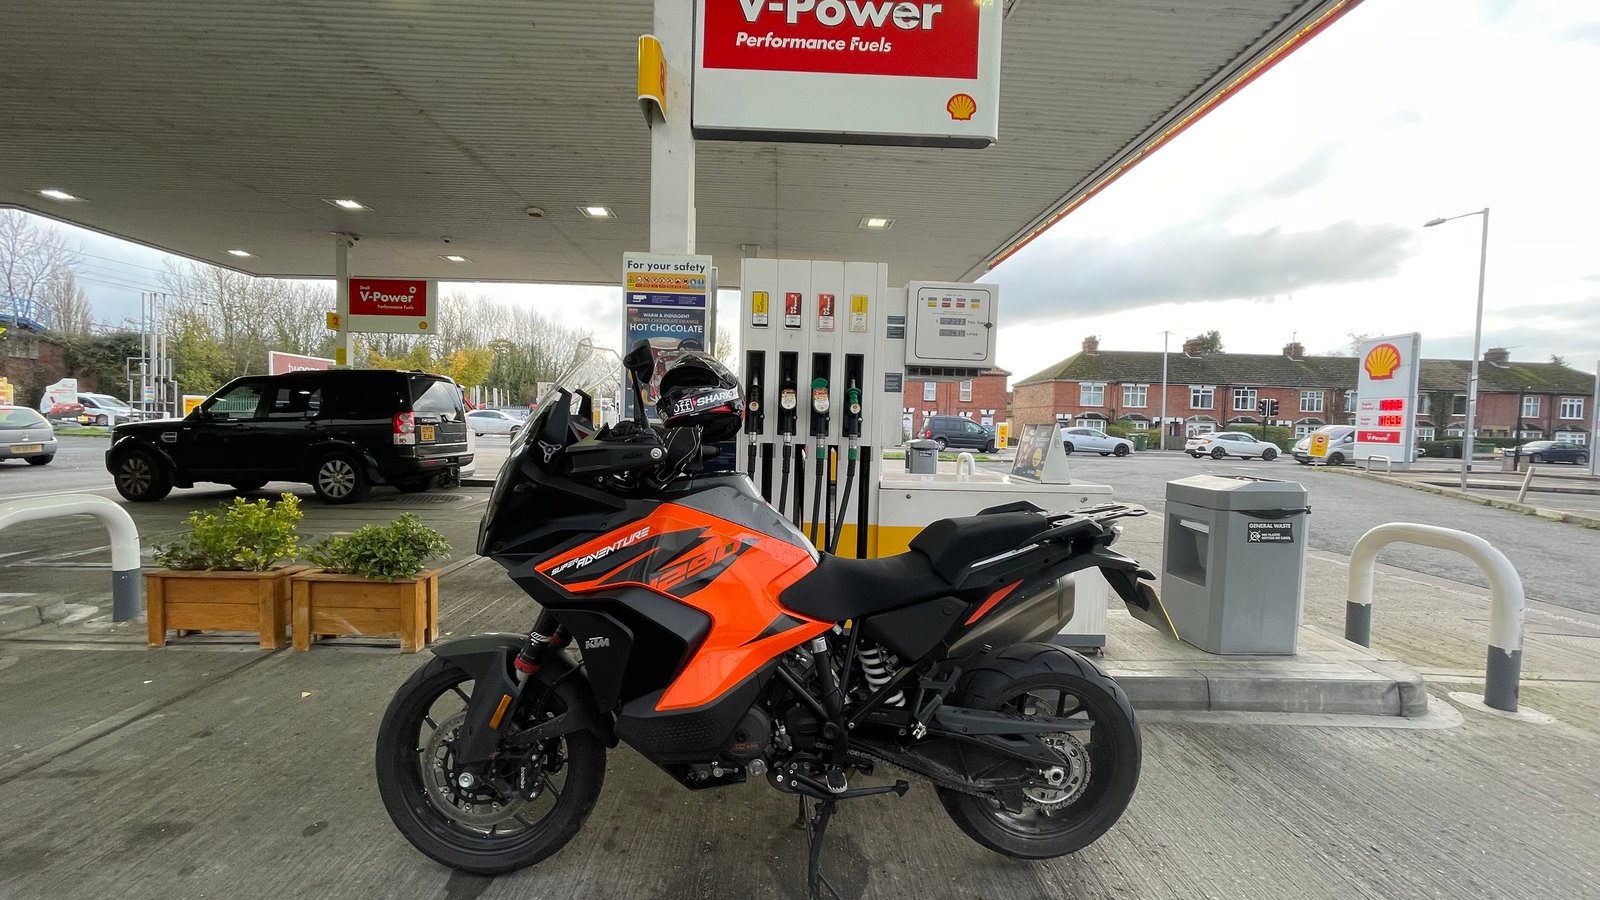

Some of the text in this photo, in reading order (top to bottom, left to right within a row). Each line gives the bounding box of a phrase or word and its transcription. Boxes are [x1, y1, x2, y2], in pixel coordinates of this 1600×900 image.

[738, 0, 943, 31] V-Power
[735, 32, 892, 53] Performance Fuels
[627, 260, 706, 273] For your safety
[360, 291, 414, 303] V-Power
[629, 323, 703, 333] HOT CHOCOLATE
[696, 391, 731, 406] SHARK
[551, 526, 650, 576] SUPER ADVENTURE
[585, 636, 610, 649] KTM
